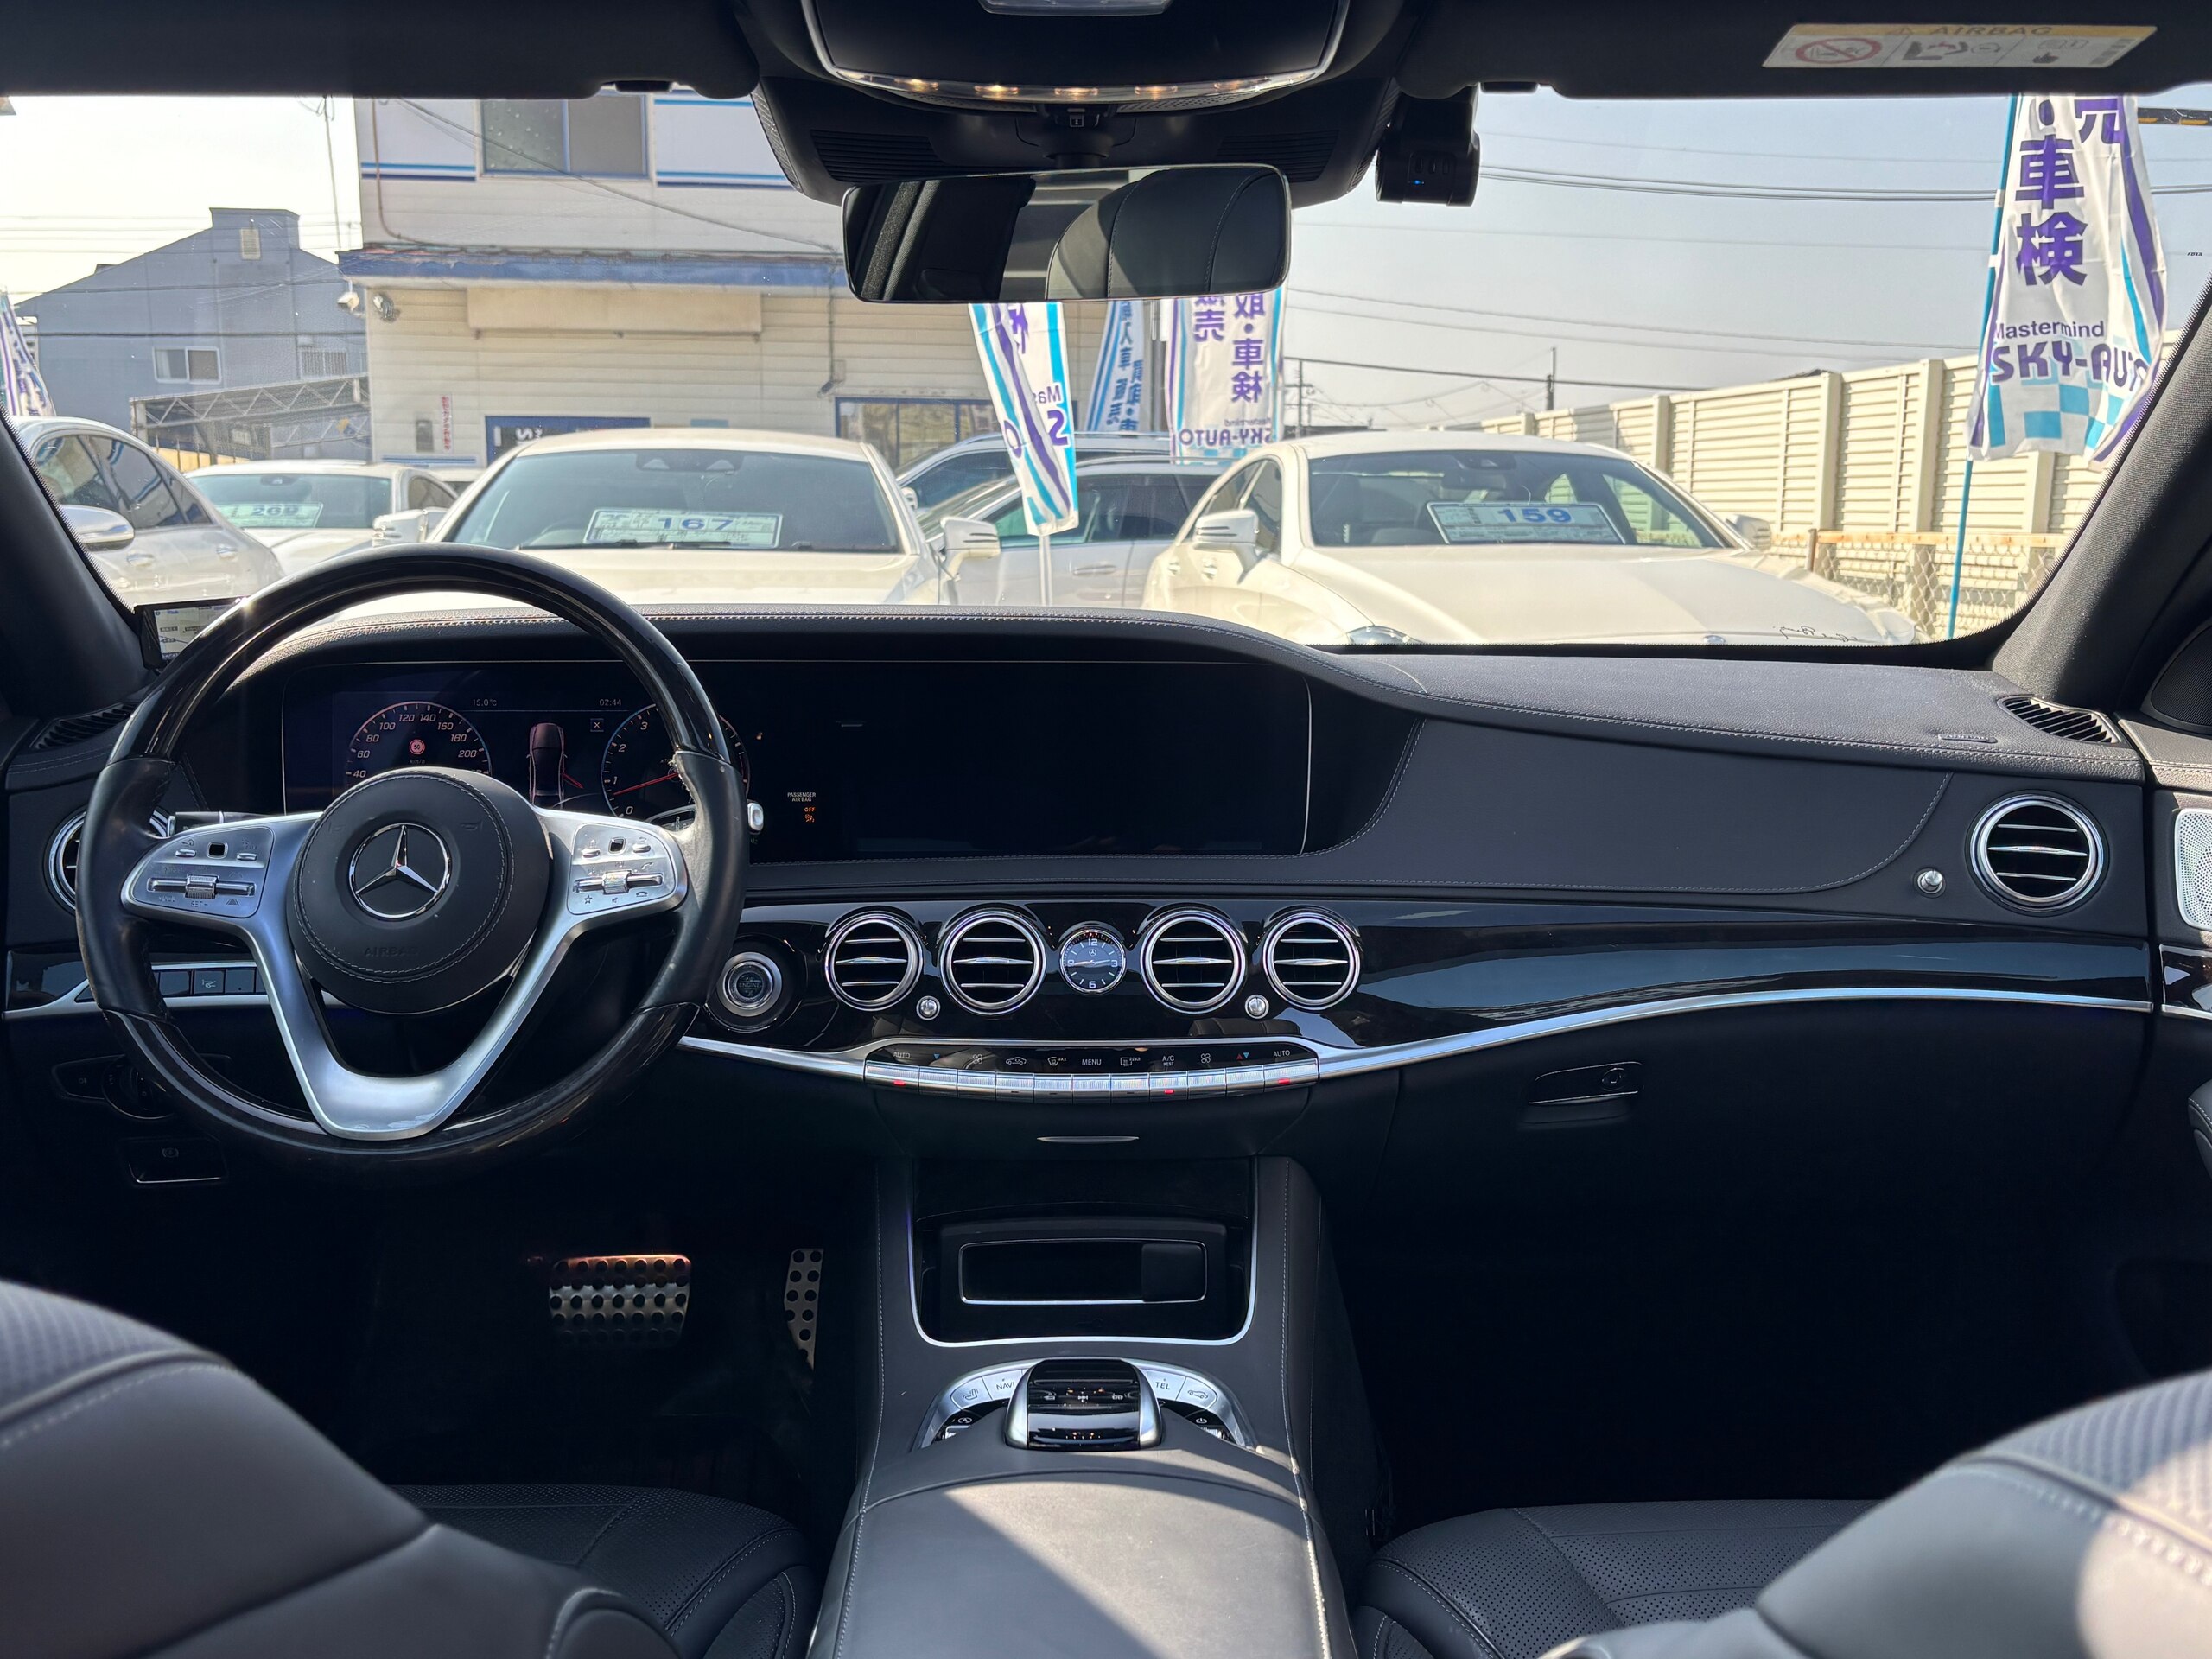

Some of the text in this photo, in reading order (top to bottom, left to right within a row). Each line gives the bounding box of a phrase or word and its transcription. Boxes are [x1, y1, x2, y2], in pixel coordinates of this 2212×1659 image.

[1930, 27, 2052, 35] AIRBAG
[1996, 321, 2105, 340] Mastermind
[1498, 508, 1572, 524] 159
[658, 518, 733, 531] 167
[640, 721, 648, 730] 3
[619, 744, 626, 753] 2
[626, 806, 633, 815] 0
[995, 1382, 1015, 1390] NAVI
[1155, 1382, 1171, 1390] TEL
